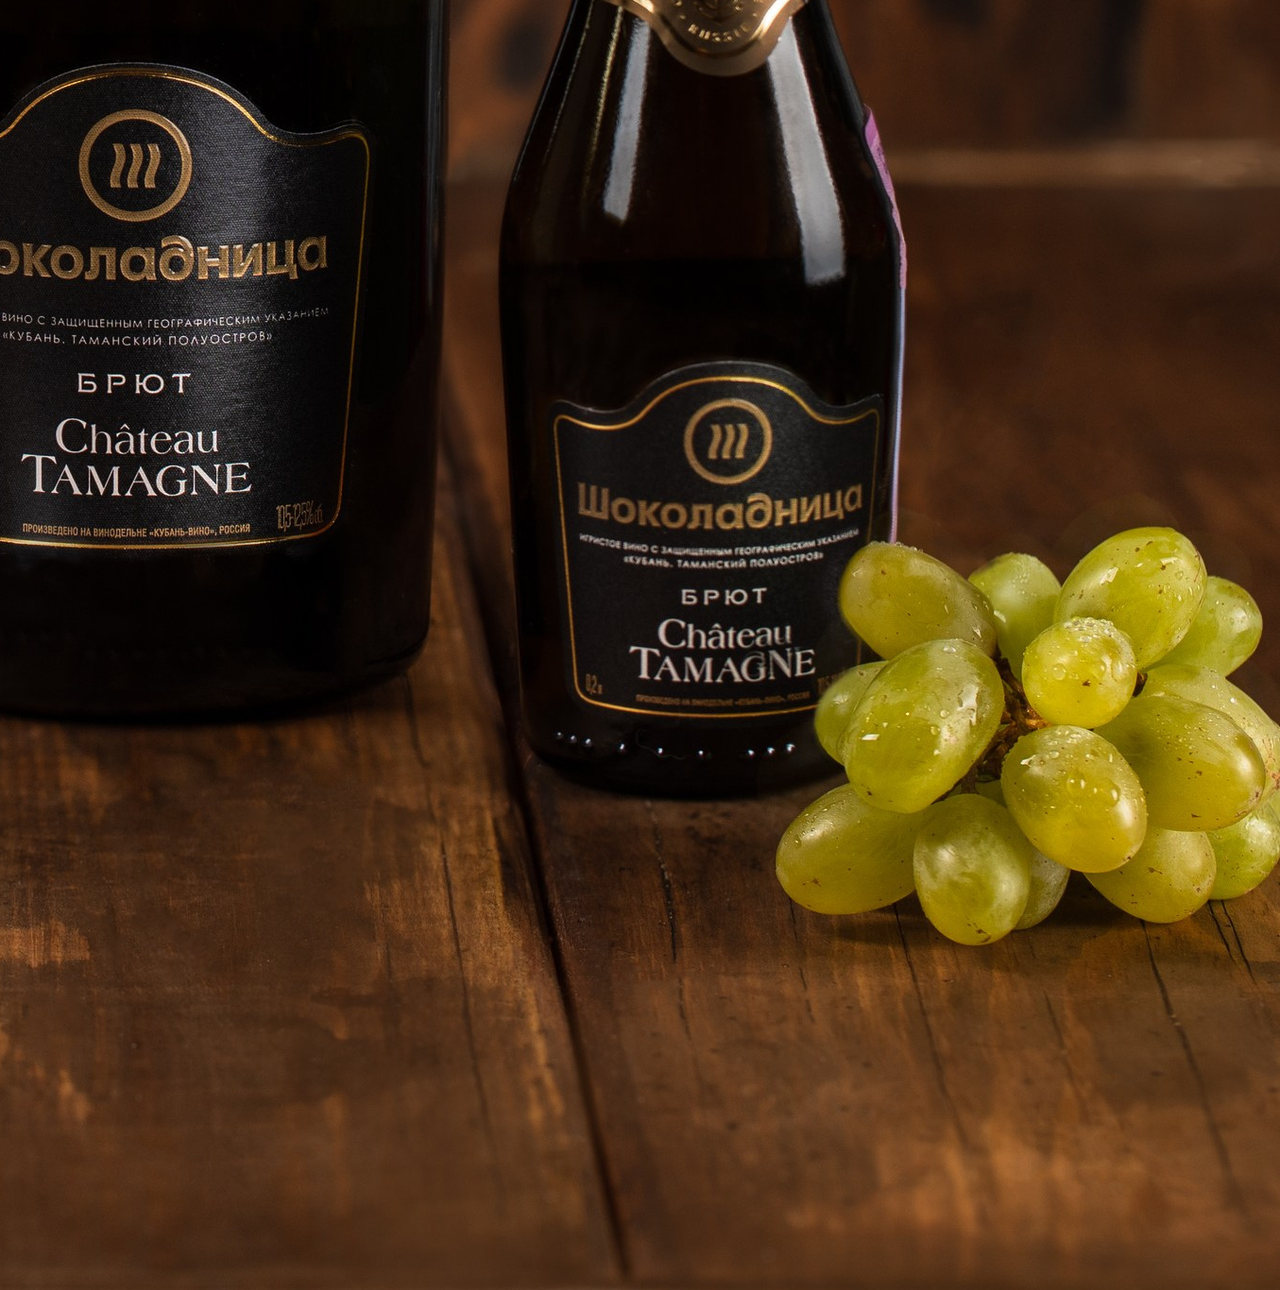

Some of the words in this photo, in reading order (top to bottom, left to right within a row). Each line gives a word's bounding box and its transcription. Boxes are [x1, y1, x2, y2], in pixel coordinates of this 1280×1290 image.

[2, 312, 33, 325] ВИНО
[37, 315, 46, 325] С
[51, 316, 143, 329] ЗАЩИЩЕННЫМ
[147, 315, 260, 329] ГЕОГРАФИЧЕСКИМ
[265, 307, 330, 323] УКАЗАНИЕМ
[3, 330, 65, 344] «КУБАНЬ.
[72, 333, 162, 347] ТАМАНСКИЙ
[169, 330, 273, 346] ПОЛУОСТРОВ»
[78, 372, 191, 394] БРЮТ
[55, 417, 219, 455] Château
[21, 453, 253, 497] TAMAGNE
[577, 481, 863, 530] Шоколадница
[22, 523, 78, 537] ПРОИЗВЕДЕНО
[80, 527, 92, 538] НА
[93, 527, 147, 539] ВИНОДЕЛЬНЕ
[219, 523, 251, 535] РОССИЯ
[623, 542, 649, 553] ВИНО
[677, 558, 747, 570] ТАМАНСКИЙ
[681, 587, 768, 605] БРЮТ
[657, 618, 792, 649] Château
[629, 645, 816, 683] TAMAGNE
